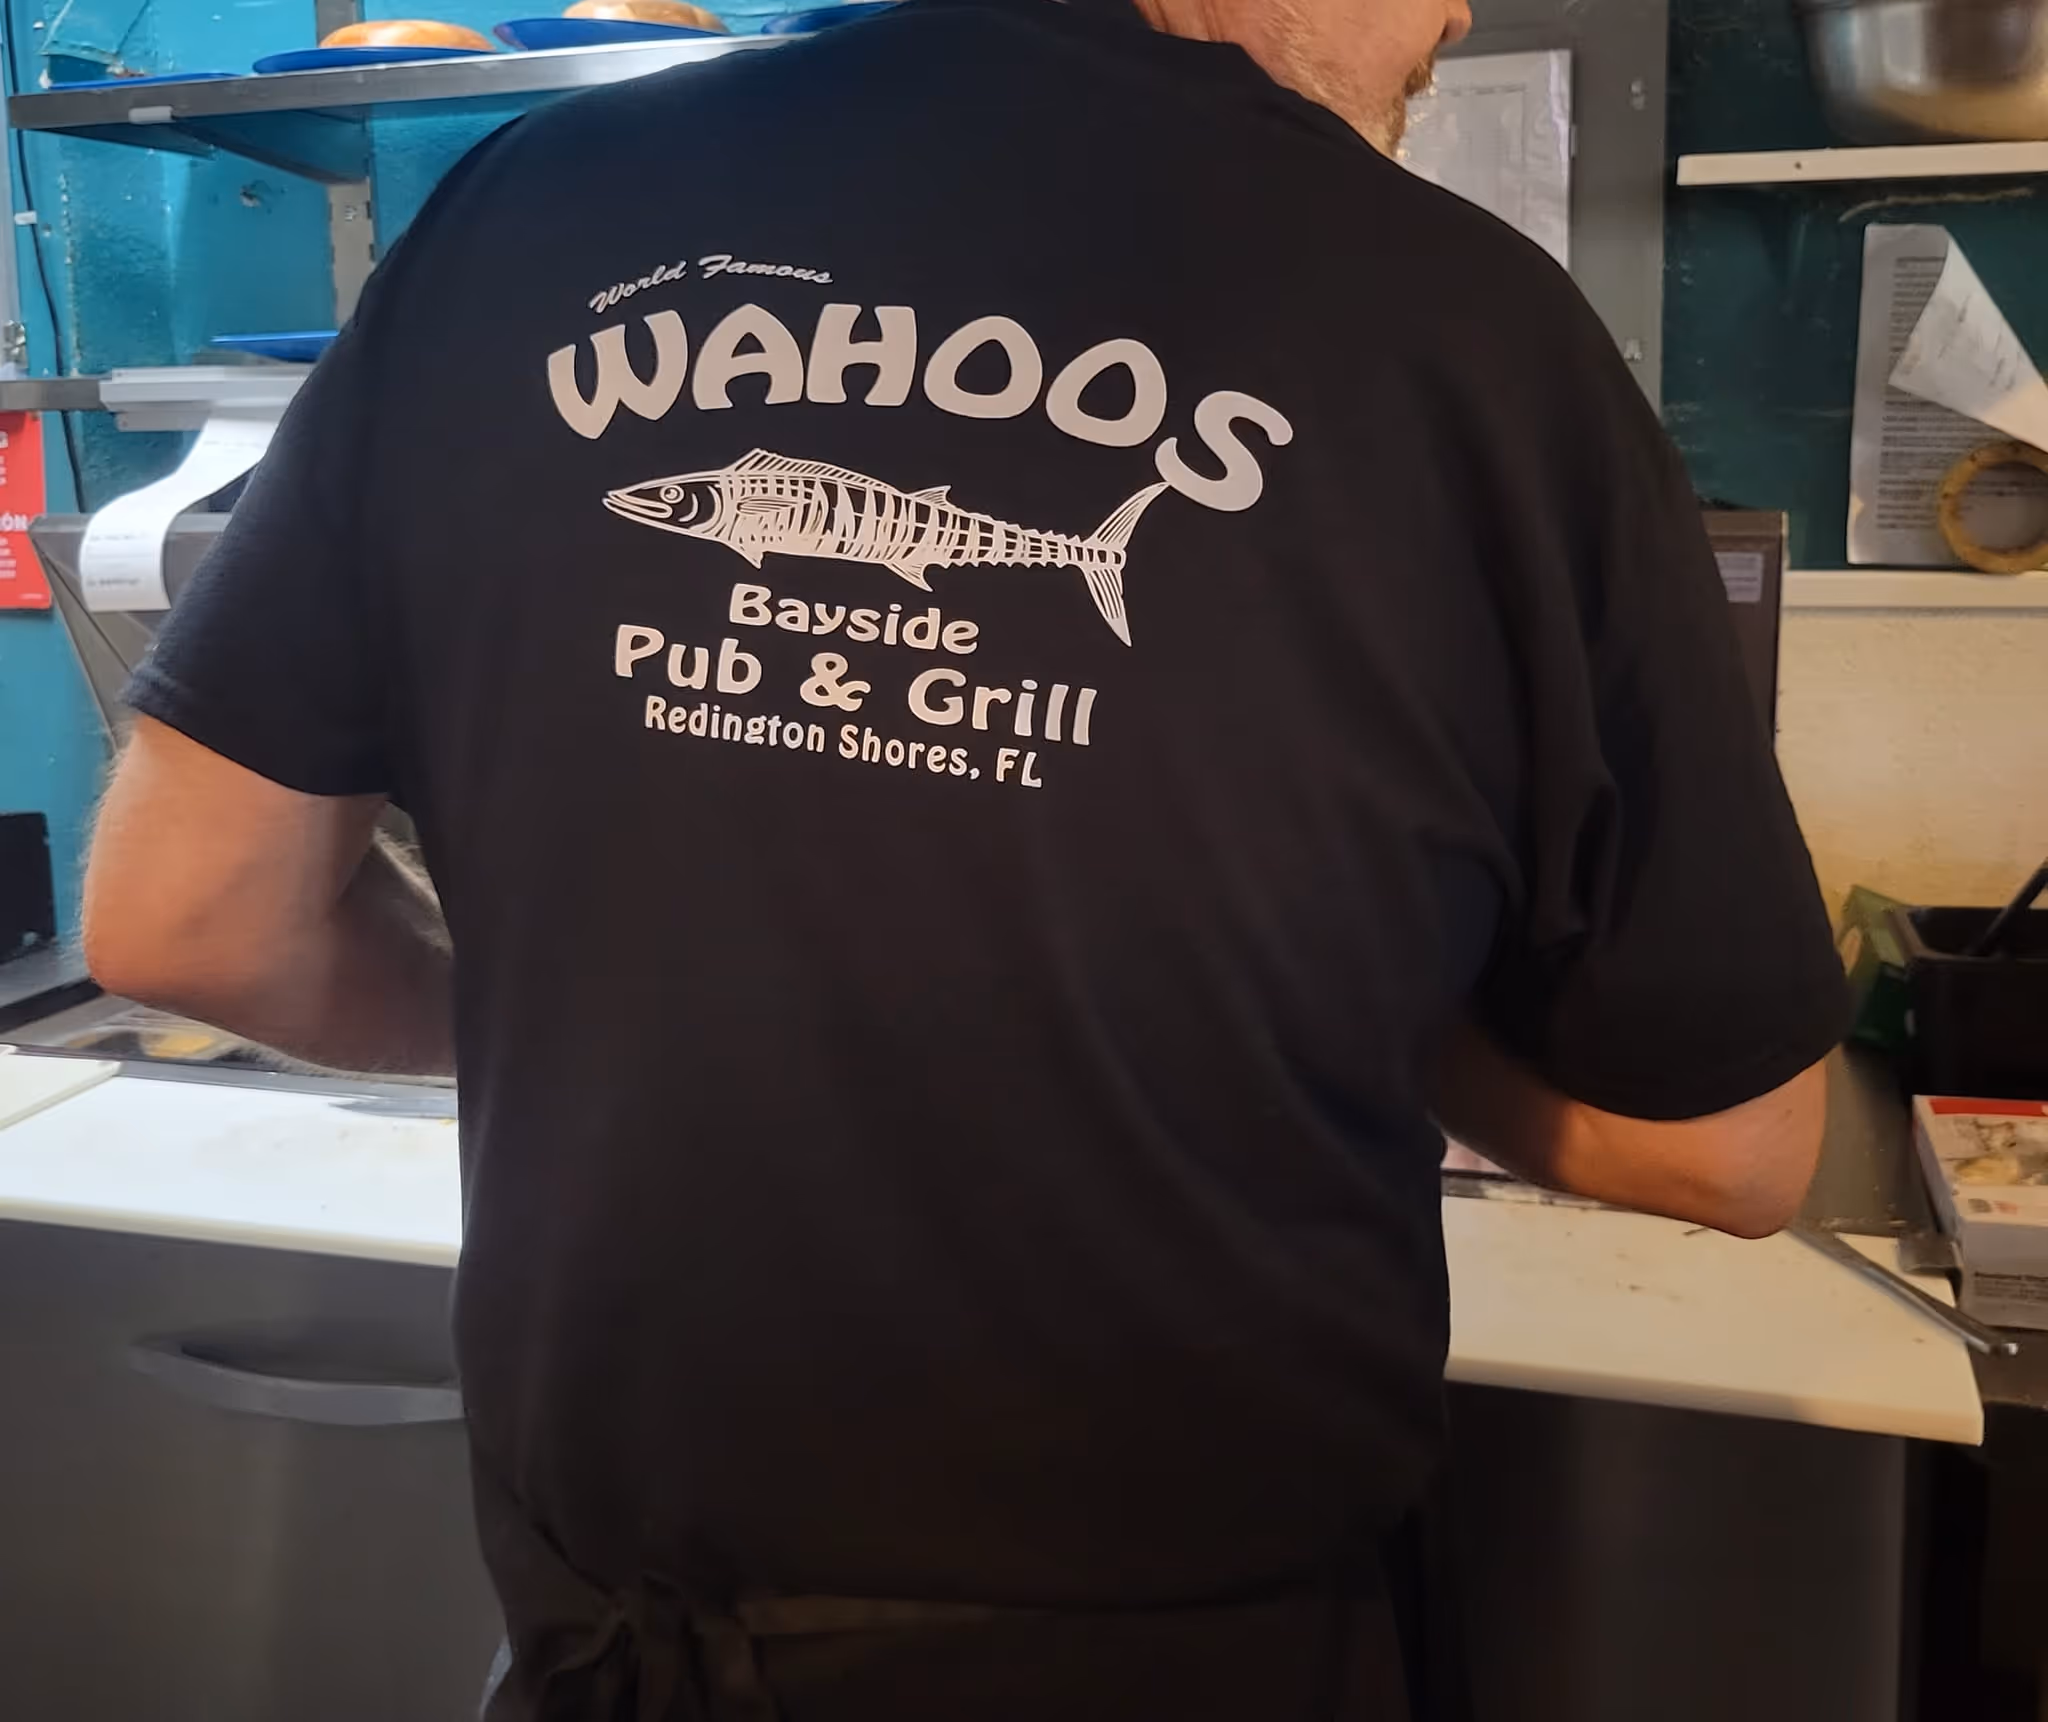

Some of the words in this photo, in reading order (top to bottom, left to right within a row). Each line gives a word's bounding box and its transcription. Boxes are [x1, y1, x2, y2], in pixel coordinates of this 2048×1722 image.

[588, 260, 687, 314] World
[698, 254, 834, 284] Famous
[547, 303, 1294, 511] WAHOOS
[729, 582, 980, 655] Bayside
[614, 623, 762, 694] Pub
[799, 651, 872, 712] &
[907, 667, 1098, 746] Grill
[644, 694, 825, 753] Redington
[838, 723, 980, 780] Shores,
[995, 747, 1043, 788] FL
